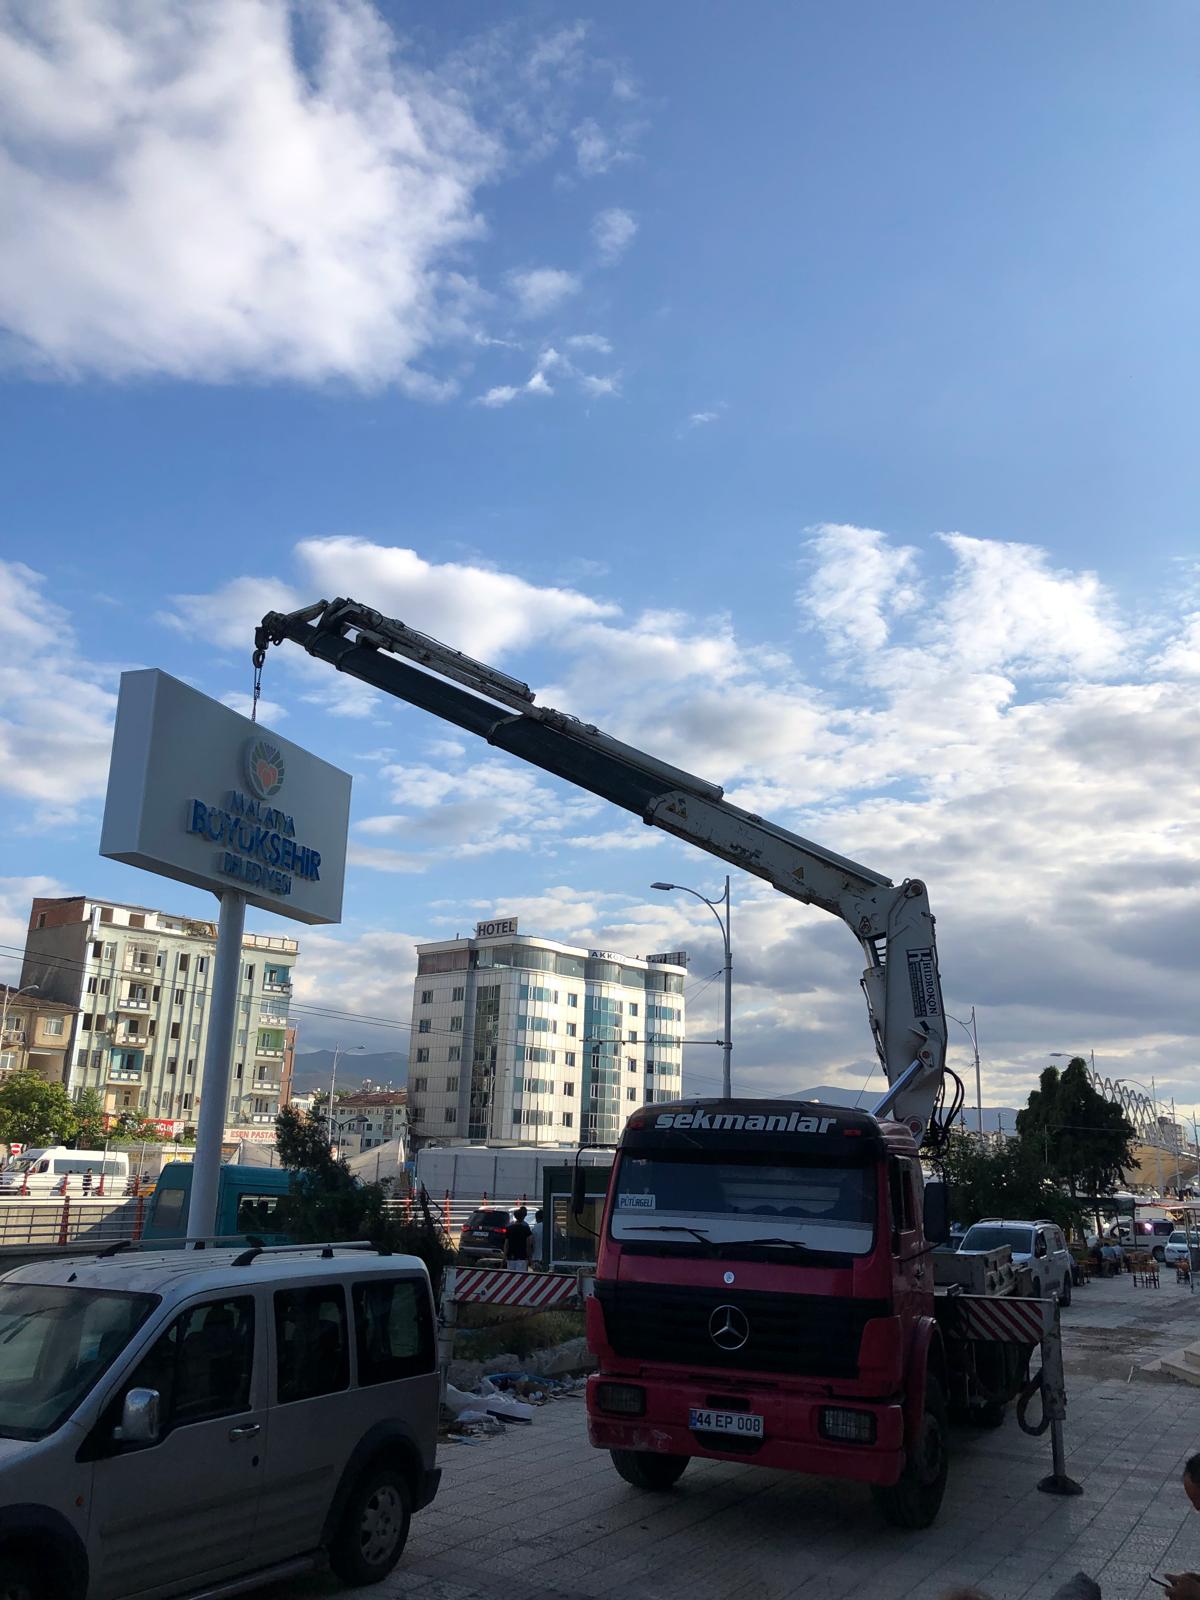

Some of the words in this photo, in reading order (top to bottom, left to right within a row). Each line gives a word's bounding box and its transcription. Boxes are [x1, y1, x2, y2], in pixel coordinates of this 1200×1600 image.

[229, 790, 296, 838] MALATYA
[189, 798, 321, 881] BÜYÜKŞEHİR
[477, 920, 516, 937] HOTEL
[654, 1109, 838, 1134] sekmanlar
[696, 1412, 712, 1427] 44
[715, 1414, 734, 1429] EP
[737, 1416, 761, 1433] 008
